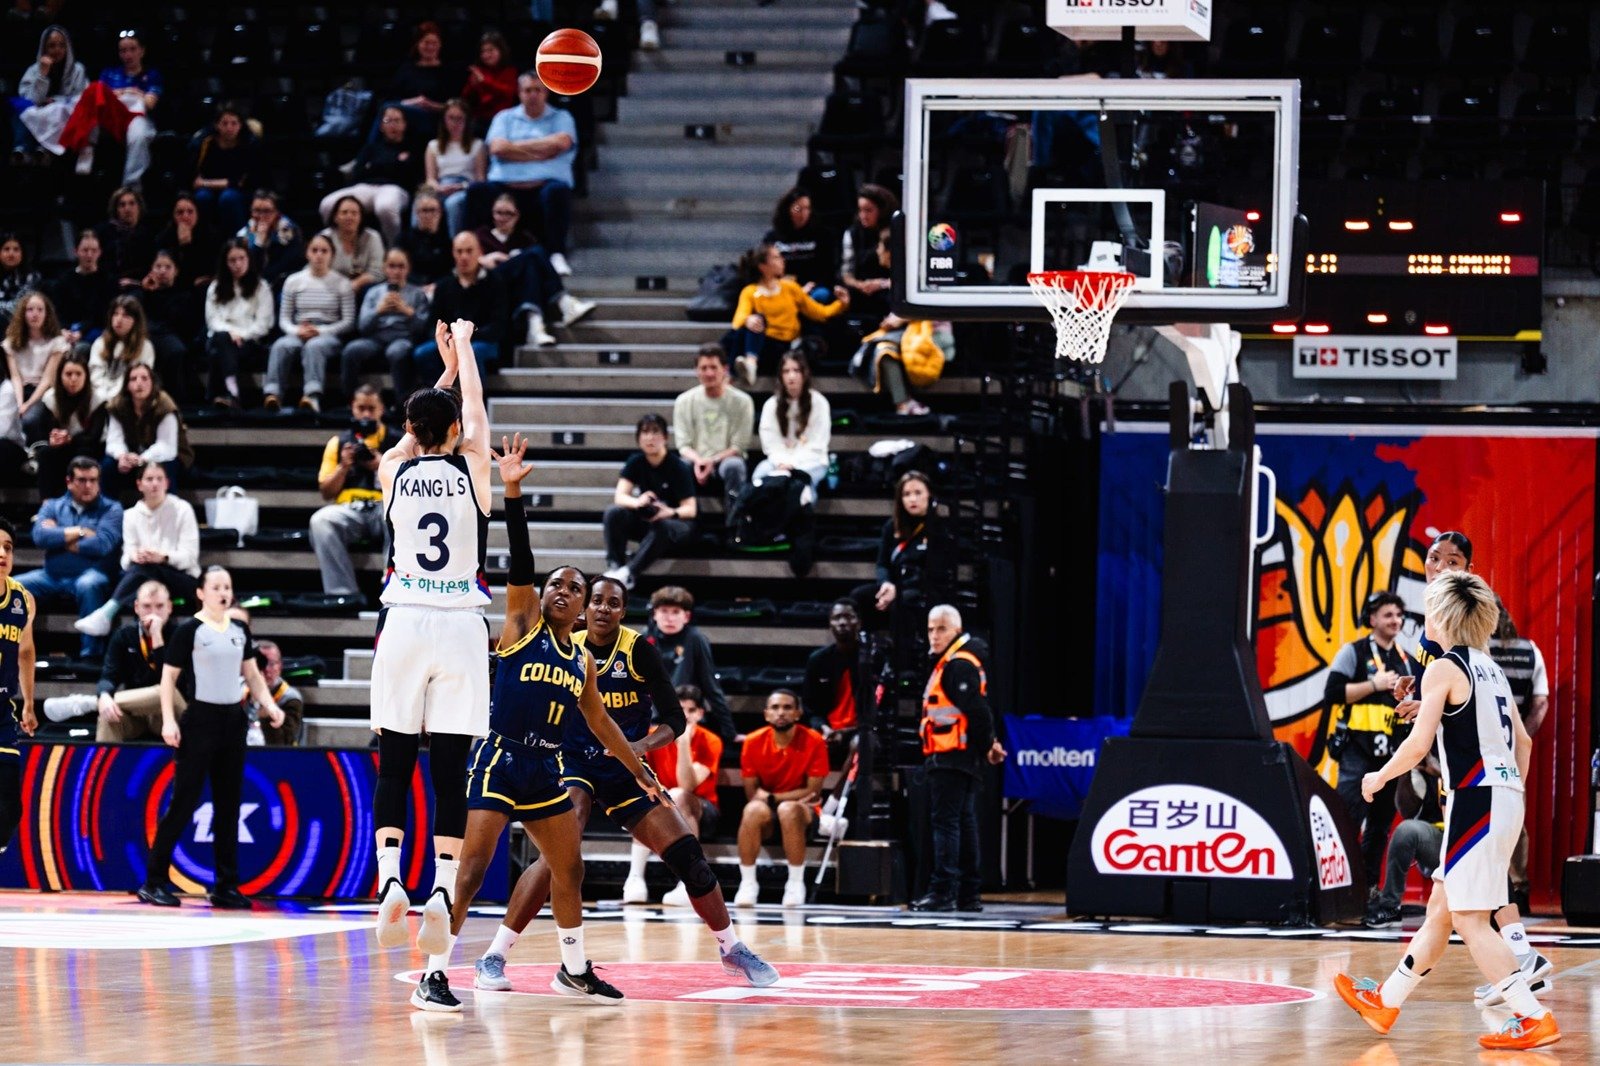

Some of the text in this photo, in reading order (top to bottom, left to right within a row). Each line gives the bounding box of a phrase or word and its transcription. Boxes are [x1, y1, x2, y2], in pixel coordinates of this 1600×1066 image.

[930, 257, 953, 269] FIBA
[1343, 348, 1451, 367] TISSOT
[400, 478, 443, 498] KANG
[416, 512, 450, 572] 3
[418, 577, 470, 594] 하나은행
[547, 701, 565, 725] 11
[1495, 695, 1513, 751] 5
[1017, 746, 1095, 767] molten
[1129, 800, 1237, 829] 百岁山
[1104, 829, 1275, 875] Ganten
